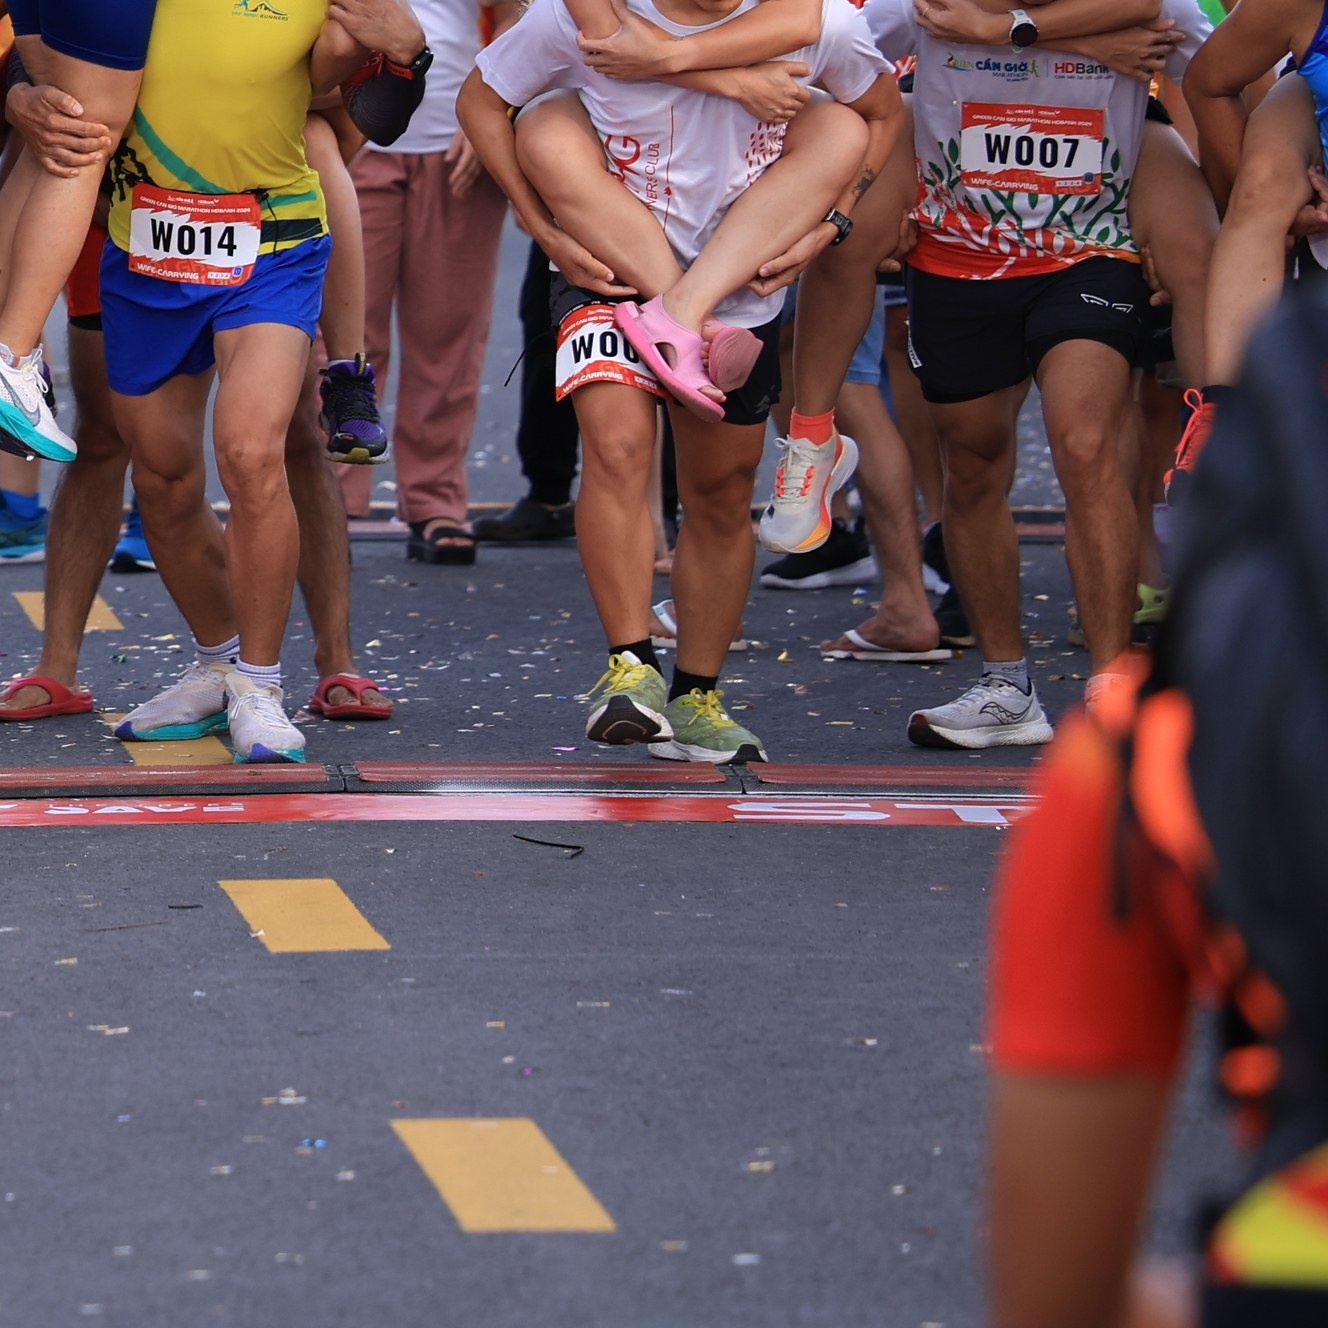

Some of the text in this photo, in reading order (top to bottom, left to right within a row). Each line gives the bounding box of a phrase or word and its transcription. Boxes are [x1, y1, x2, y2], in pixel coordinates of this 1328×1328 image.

[644, 143, 660, 176] CLUB
[985, 133, 1079, 168] W007
[971, 177, 1038, 191] WIFE-CARRYING
[151, 218, 237, 256] W014
[137, 263, 199, 279] WIFE-CARRYING
